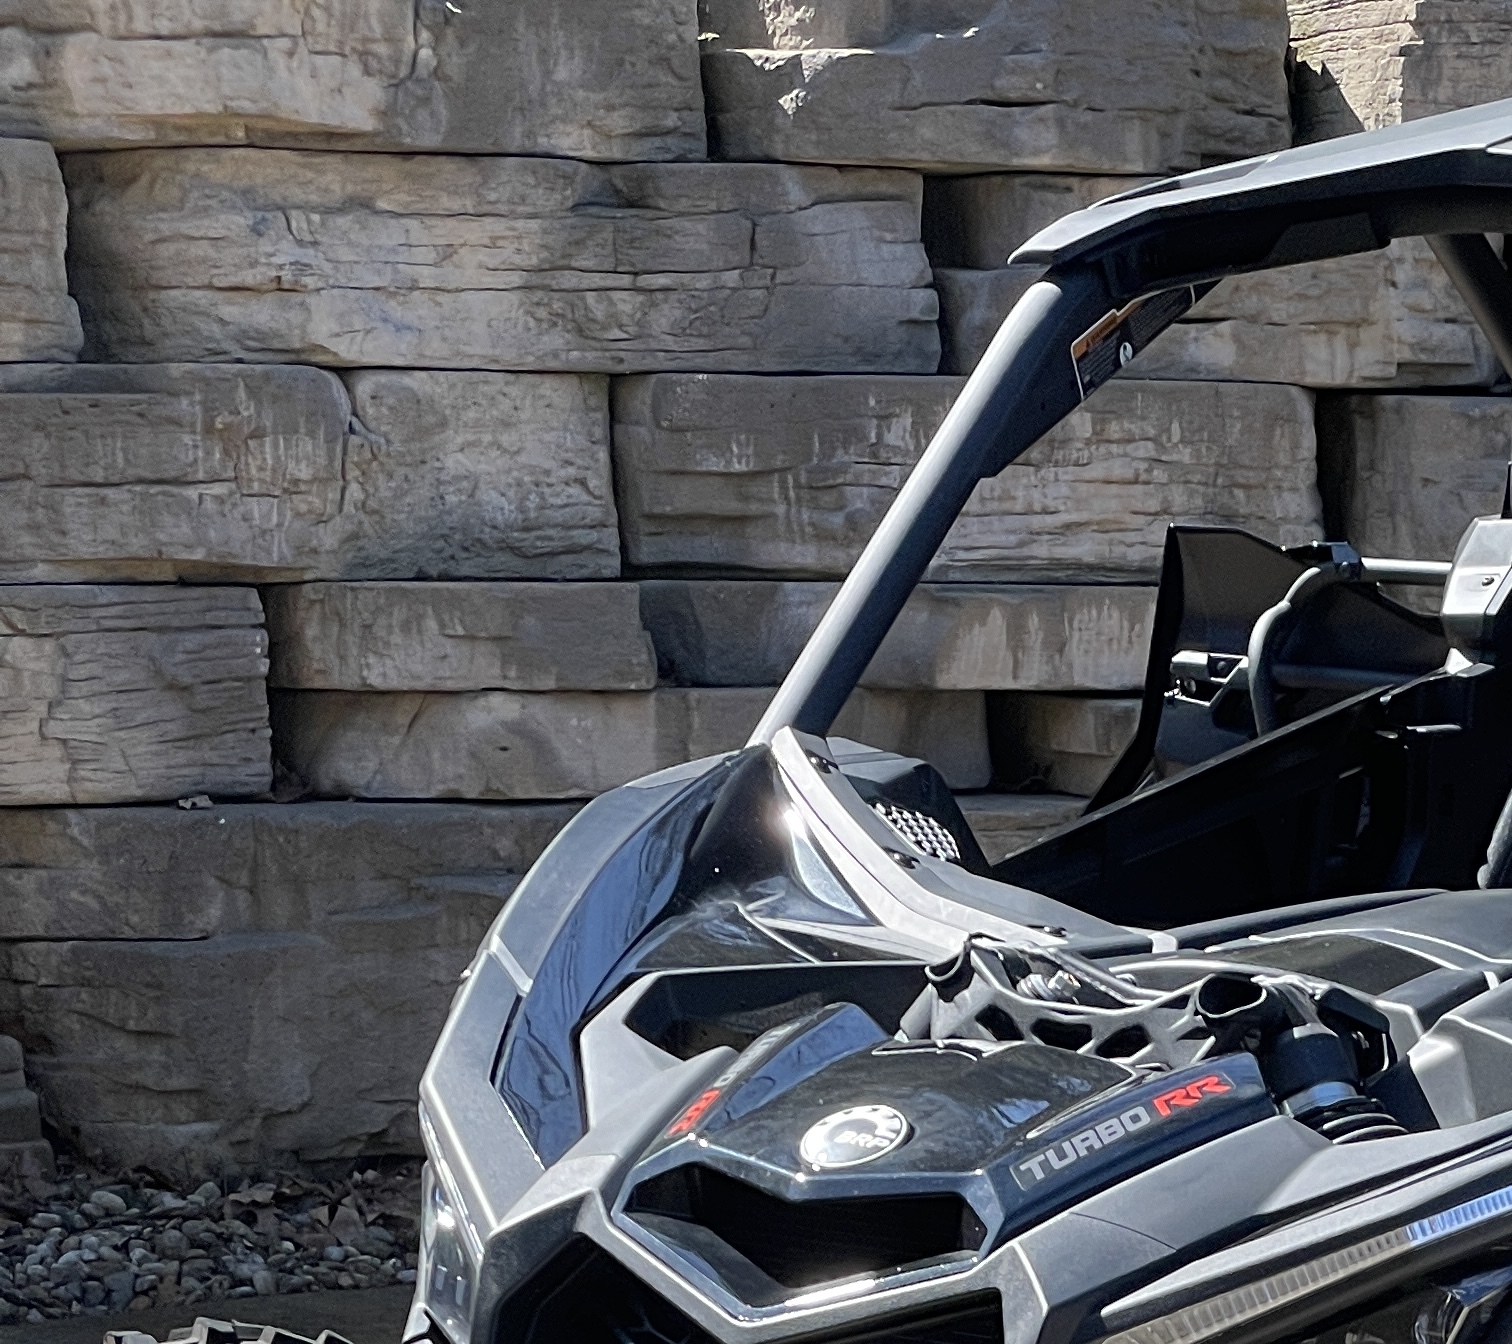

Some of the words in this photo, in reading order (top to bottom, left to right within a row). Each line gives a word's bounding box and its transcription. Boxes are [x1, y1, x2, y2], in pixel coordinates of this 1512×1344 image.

[834, 1130, 891, 1149] BRP
[1019, 1107, 1151, 1182] TURBO
[1152, 1074, 1232, 1118] RR
